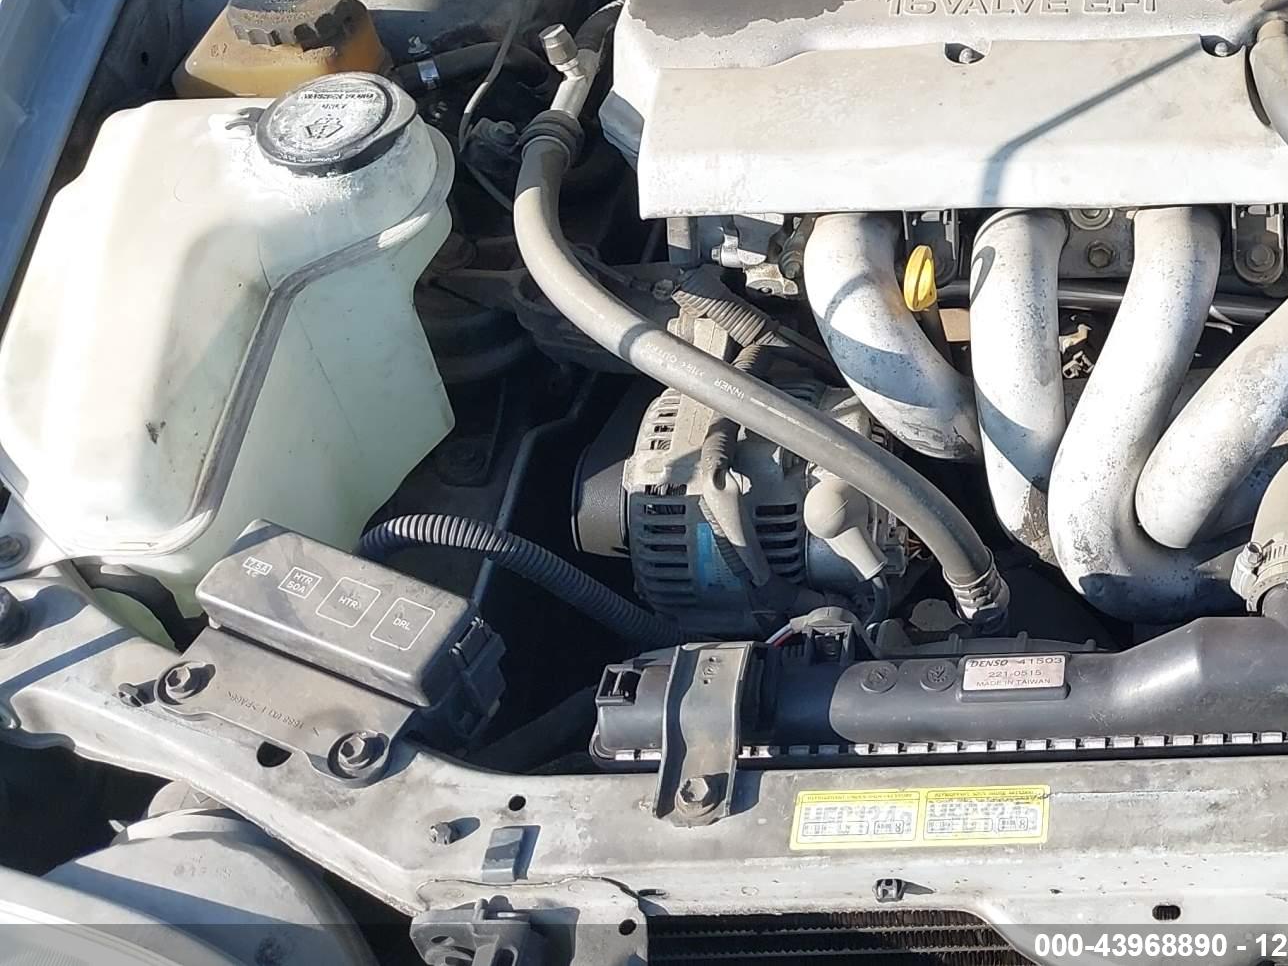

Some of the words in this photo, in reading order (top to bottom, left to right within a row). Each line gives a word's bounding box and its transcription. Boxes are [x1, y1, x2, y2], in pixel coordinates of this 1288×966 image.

[714, 378, 745, 400] INNER
[293, 573, 313, 584] HTR
[286, 581, 306, 593] 50A
[338, 596, 358, 609] HTR
[393, 617, 411, 631] DRL
